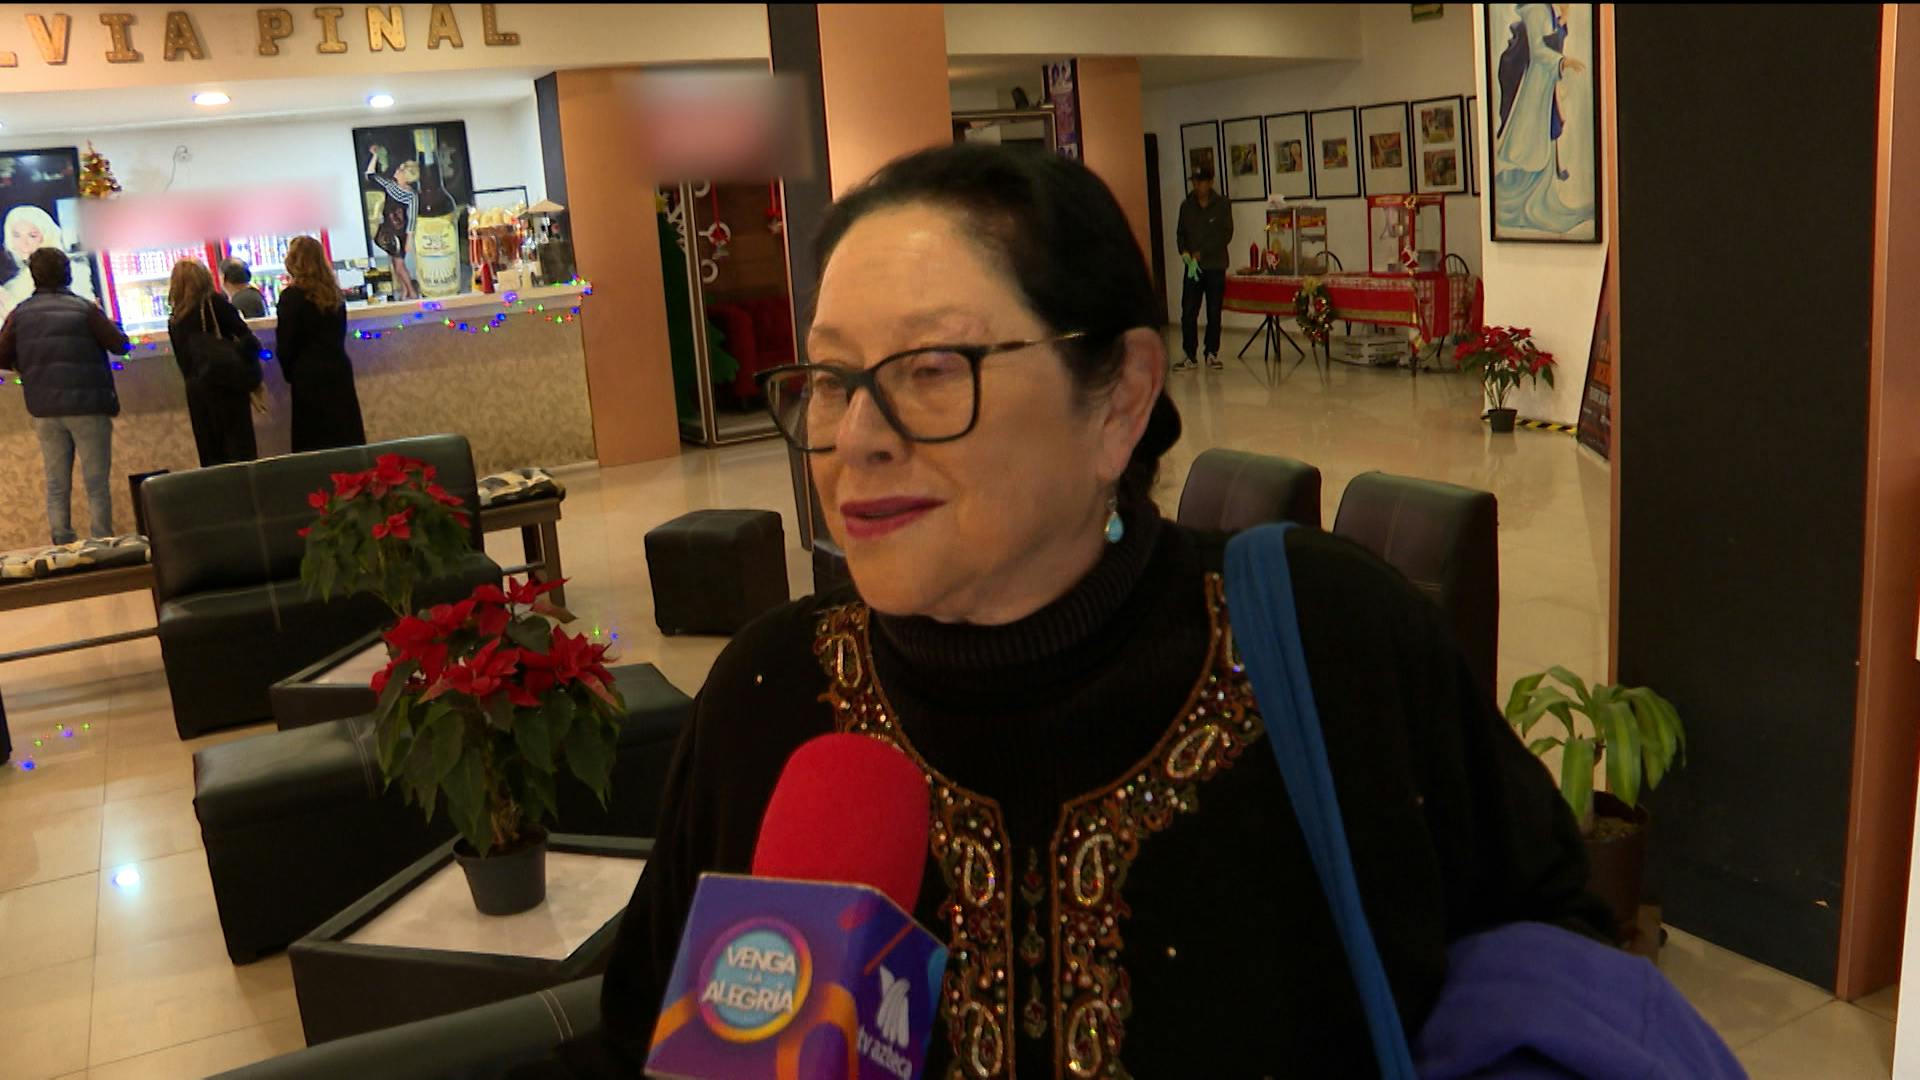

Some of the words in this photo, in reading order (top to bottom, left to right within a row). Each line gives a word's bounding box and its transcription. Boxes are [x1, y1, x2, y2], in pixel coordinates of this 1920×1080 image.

[257, 4, 520, 56] PINAL
[727, 944, 797, 977] VENGA
[857, 1022, 873, 1055] tv
